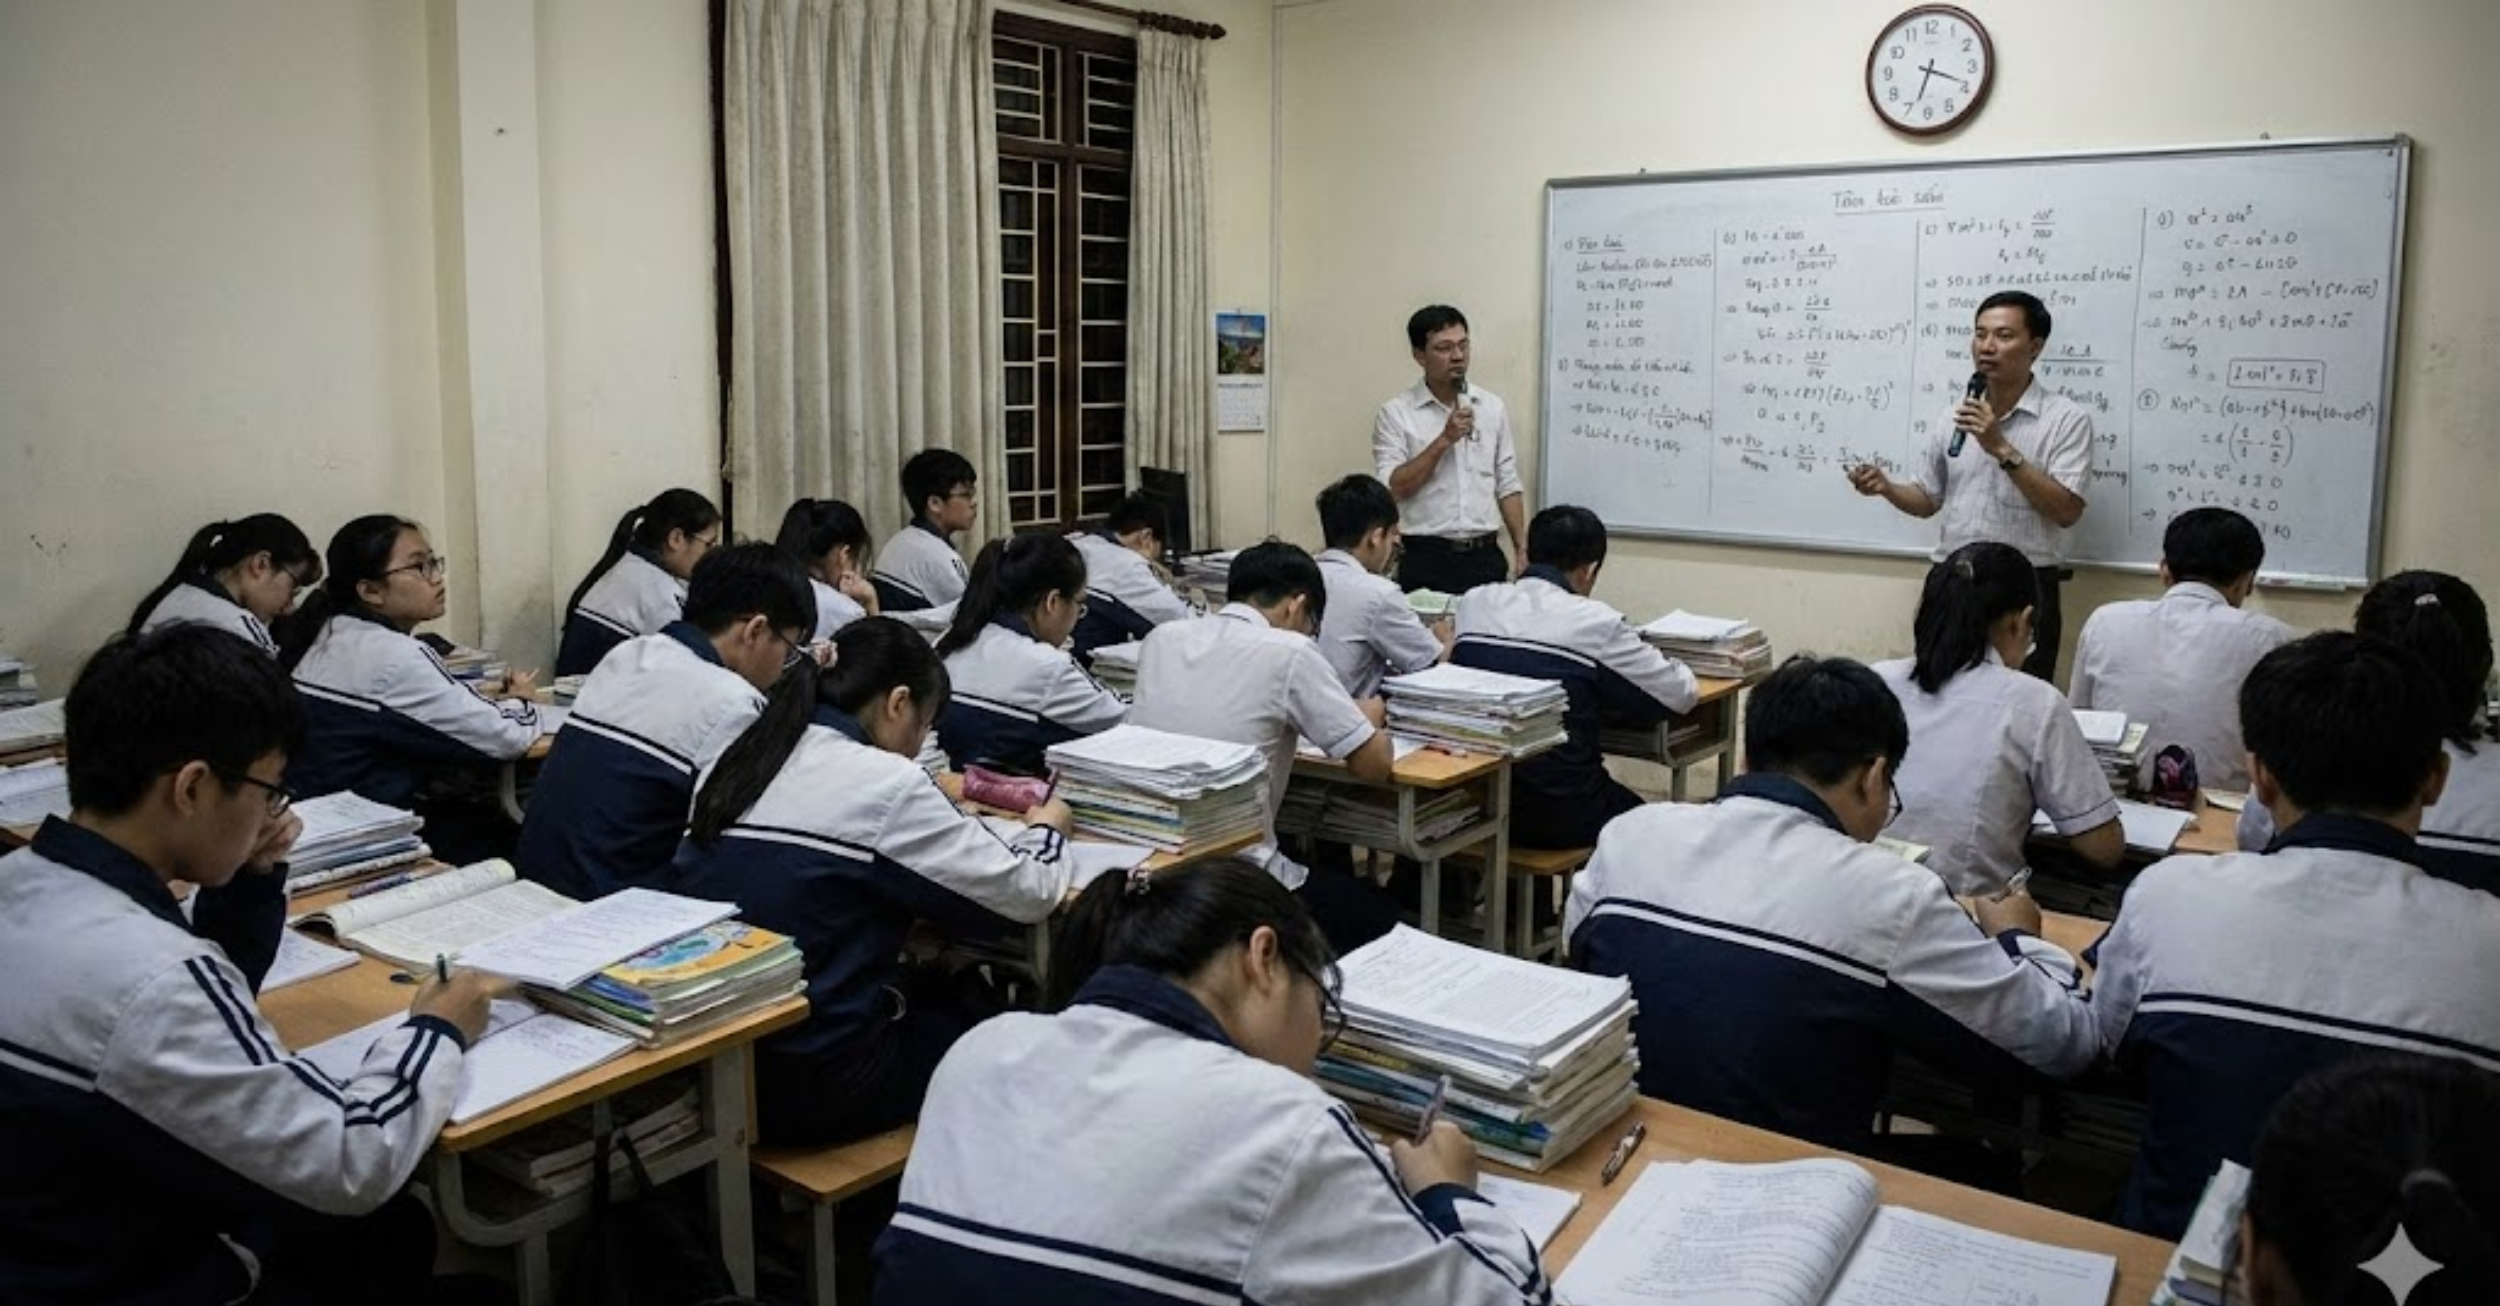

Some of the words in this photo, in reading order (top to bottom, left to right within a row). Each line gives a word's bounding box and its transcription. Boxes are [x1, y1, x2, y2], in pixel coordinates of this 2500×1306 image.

[1905, 27, 1917, 42] 11
[1924, 20, 1939, 35] 12
[1950, 23, 1956, 38] 1
[1962, 38, 1973, 52] 2
[1884, 66, 1893, 81] 9
[1967, 59, 1978, 74] 3
[1889, 86, 1898, 101] 8
[1904, 102, 1914, 116] 7
[1923, 106, 1933, 120] 6
